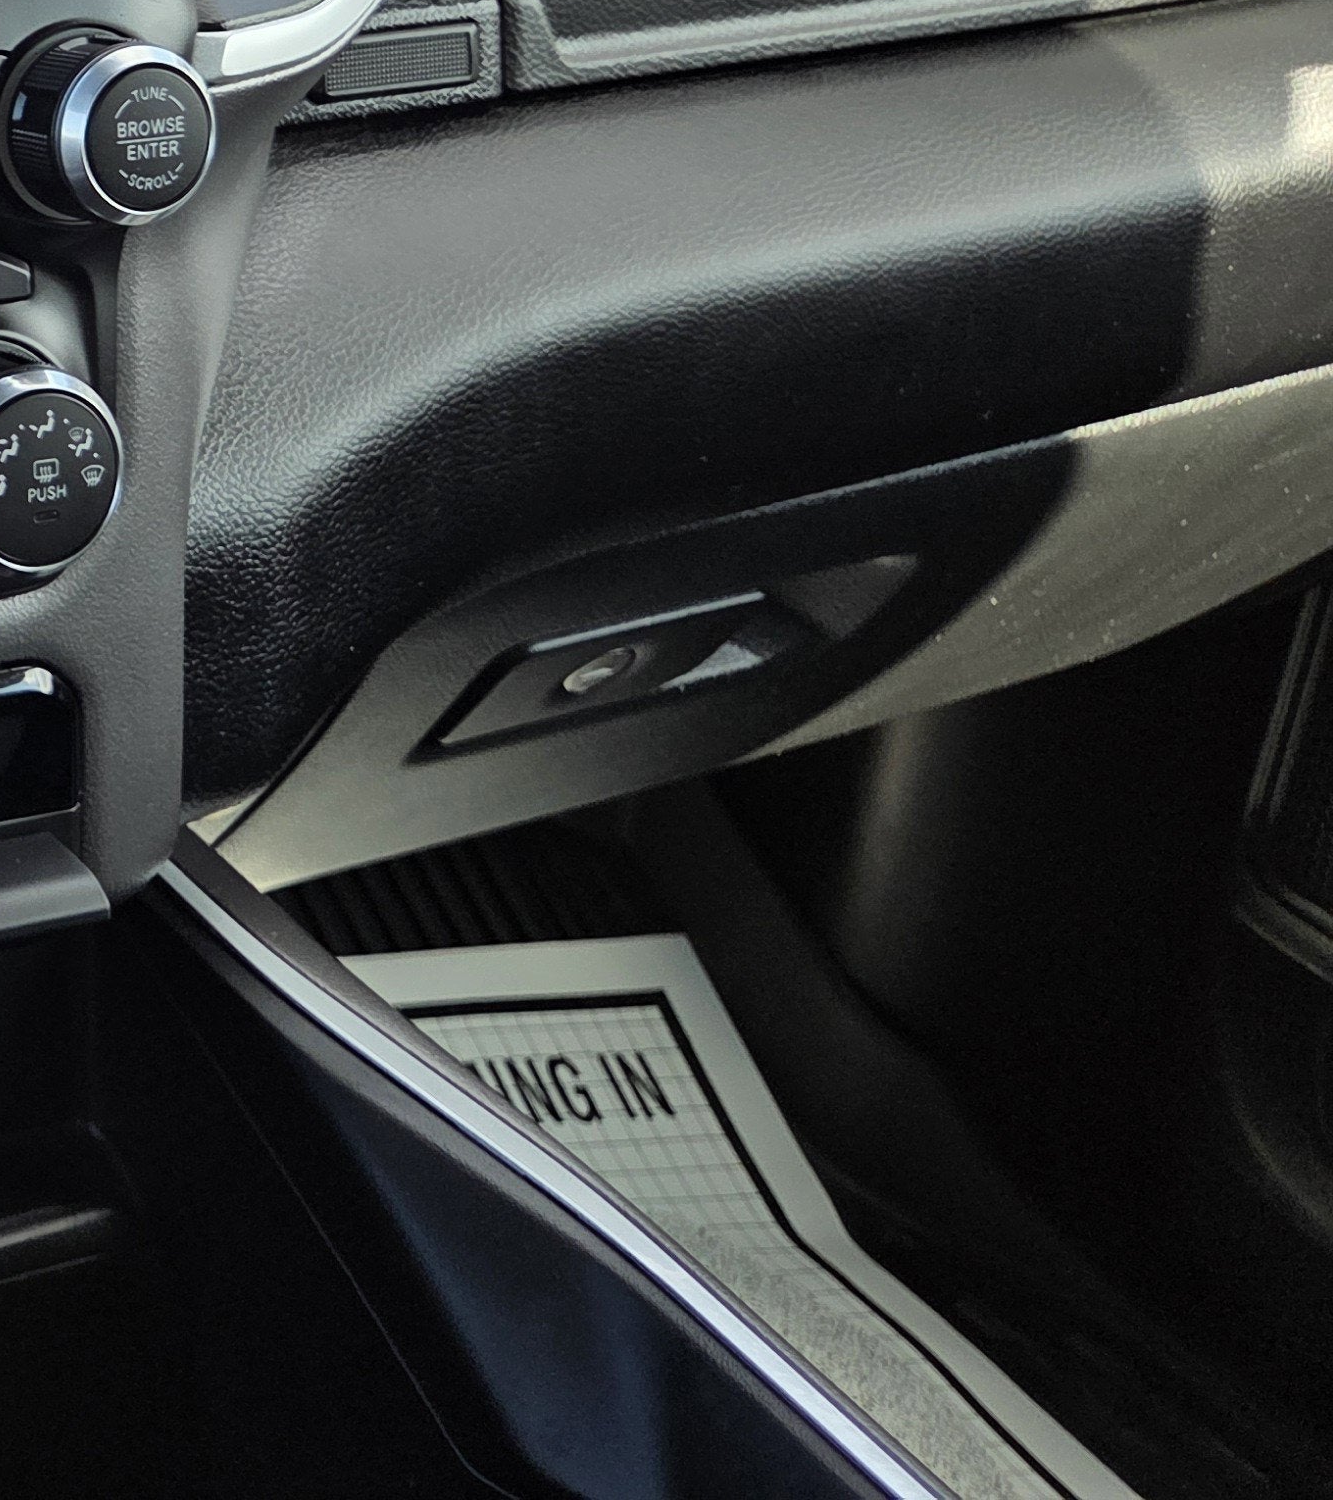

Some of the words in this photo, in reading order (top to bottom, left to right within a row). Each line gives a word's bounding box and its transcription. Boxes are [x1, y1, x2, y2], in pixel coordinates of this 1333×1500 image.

[130, 87, 168, 103] TUNE
[117, 116, 184, 138] BROWSE
[126, 140, 179, 162] ENTER
[128, 170, 179, 191] SCROLL
[27, 484, 67, 503] PUSH
[598, 1050, 676, 1117] IN
